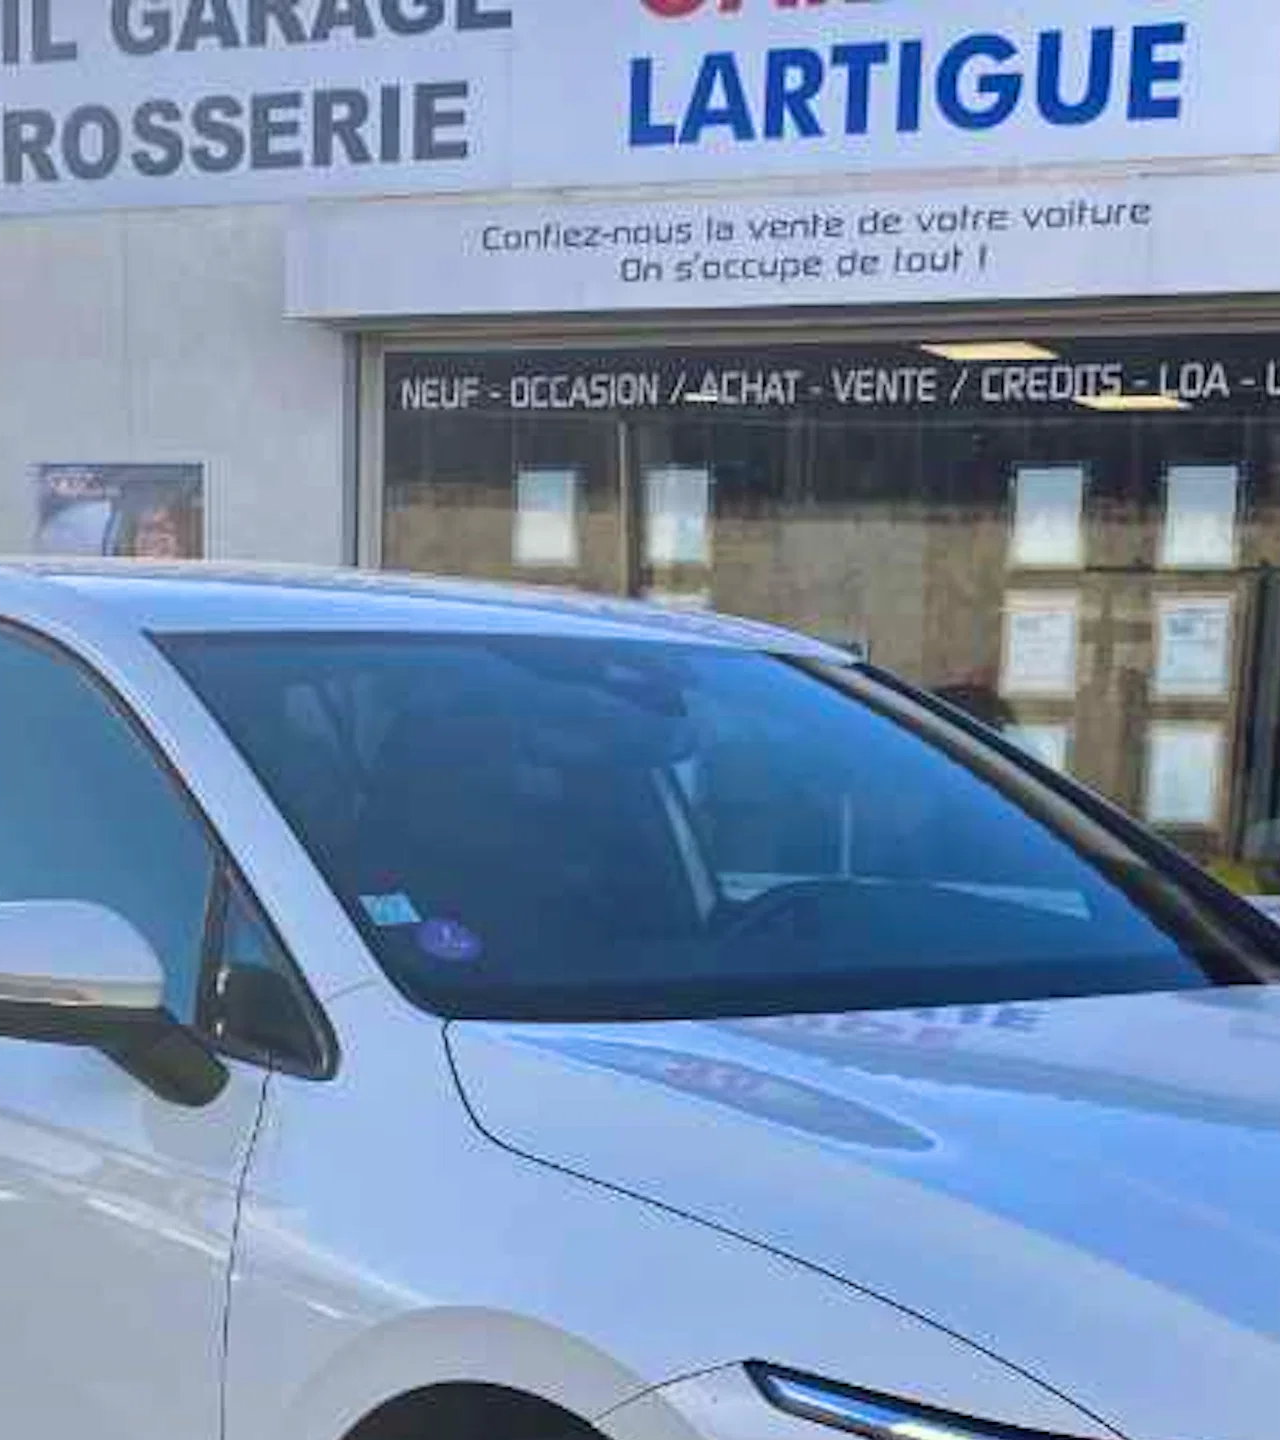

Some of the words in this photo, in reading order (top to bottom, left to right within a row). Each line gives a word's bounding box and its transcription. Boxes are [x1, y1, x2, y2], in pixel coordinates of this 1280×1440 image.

[628, 22, 1187, 147] LARTIGUE
[481, 219, 693, 252] Confiez-nous
[706, 216, 734, 243] la
[748, 213, 845, 241] vente
[857, 209, 903, 236] de
[917, 204, 1010, 234] votre
[1023, 200, 1153, 230] voiture
[620, 256, 664, 283] On
[674, 252, 822, 283] s'occupe
[837, 248, 881, 277] de
[894, 243, 964, 274] tout
[401, 376, 480, 410] NEUF
[509, 371, 661, 410] OCCASION
[696, 368, 800, 407] ACHAT
[832, 365, 938, 405] VENTE
[980, 361, 1123, 402] CREDITS
[1159, 360, 1230, 400] LOA
